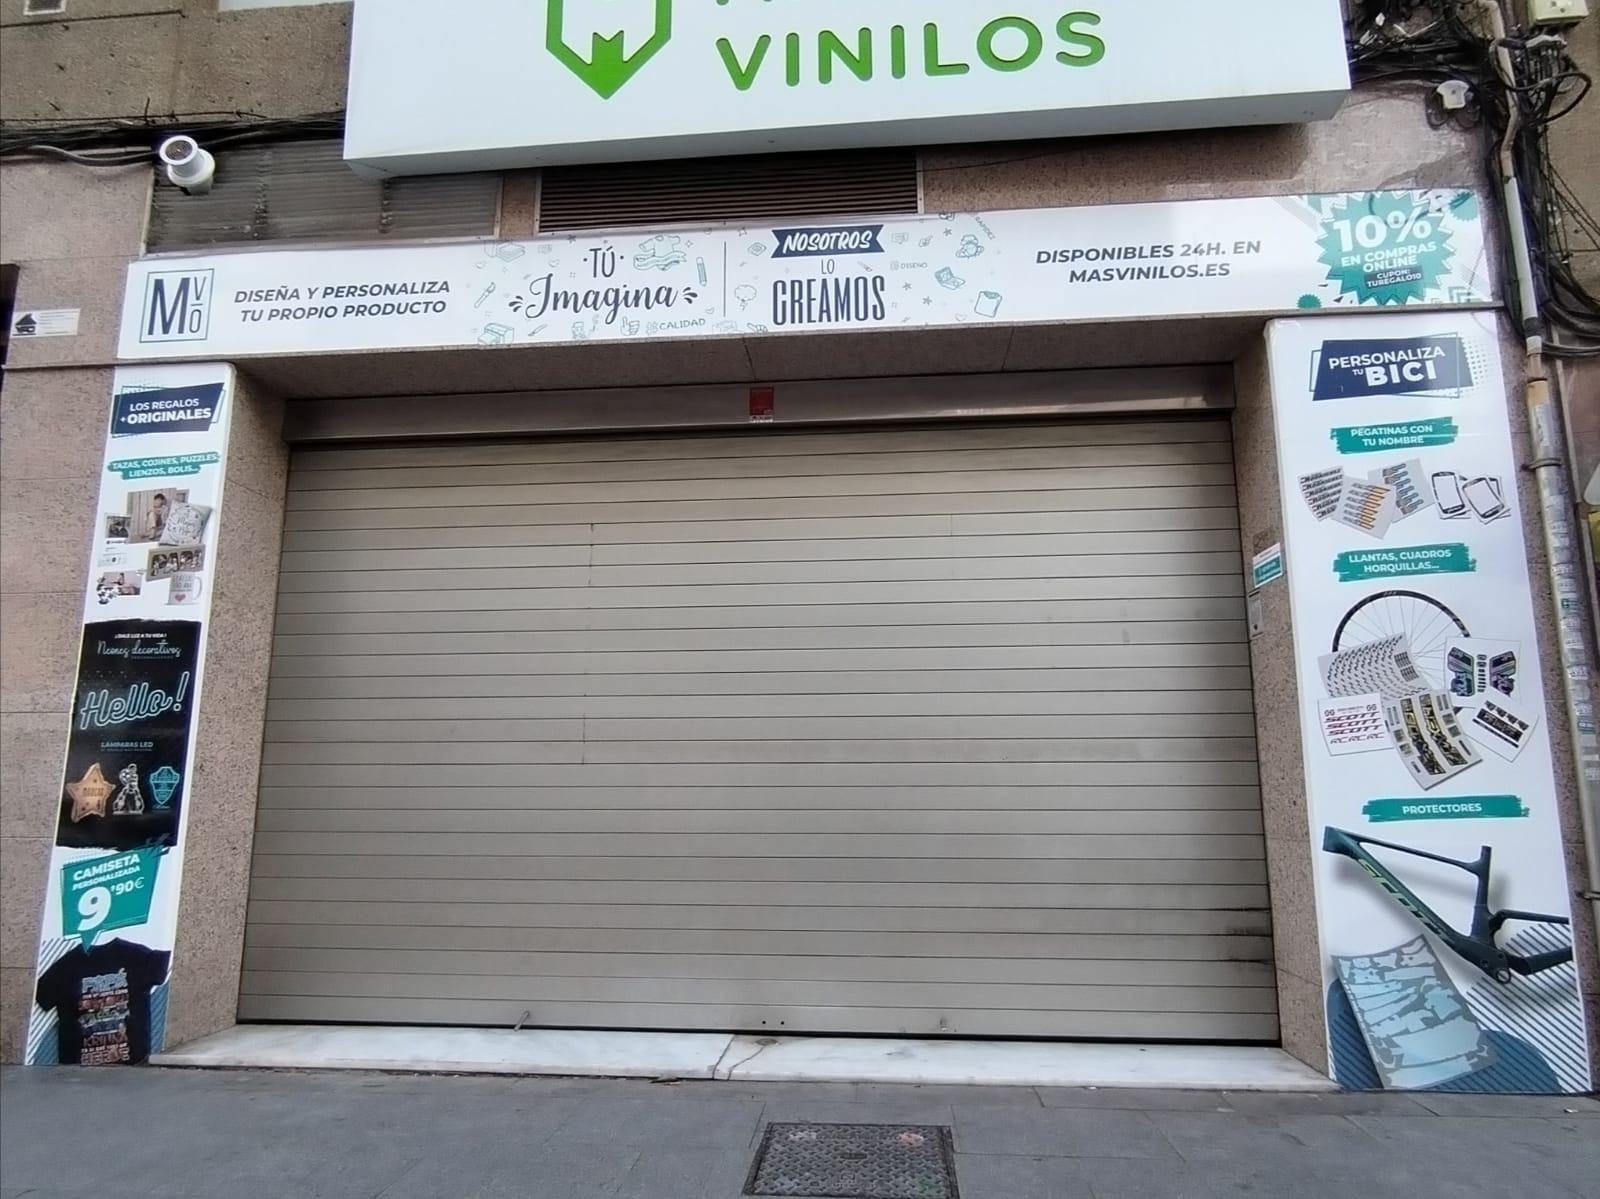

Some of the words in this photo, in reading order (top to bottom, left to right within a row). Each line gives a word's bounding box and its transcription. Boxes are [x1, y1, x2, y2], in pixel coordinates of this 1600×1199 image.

[716, 11, 1105, 91] VINILOS
[1333, 206, 1432, 252] 10%
[782, 231, 873, 254] NOSOTROS
[1036, 244, 1174, 264] DISPONIBLES
[1180, 242, 1226, 257] 24H.
[1232, 240, 1261, 254] EN
[1341, 254, 1361, 267] EN
[1364, 242, 1437, 262] COMPRAS
[1363, 255, 1417, 273] ONLINE
[821, 259, 835, 275] LO
[1069, 263, 1230, 283] MASVINILOS.ES
[234, 285, 301, 303] DISEÑA
[307, 287, 318, 299] Y
[322, 281, 450, 299] PERSONALIZA
[525, 273, 678, 325] Imagina
[772, 275, 885, 326] CREAMOS
[241, 309, 263, 322] TU
[268, 306, 337, 321] PROPIO
[343, 300, 447, 317] PRODUCTO
[1328, 346, 1446, 369] PERSONALIZA
[1352, 368, 1364, 376] TU
[1364, 360, 1437, 387] BICI
[129, 402, 150, 412] LOS
[152, 398, 200, 410] REGALOS
[1351, 425, 1409, 437] PEGATINAS
[1410, 425, 1433, 433] CON
[1362, 438, 1376, 447] TU
[1378, 436, 1424, 446] NOMBRE
[1349, 552, 1396, 563] LLANTAS,
[1400, 549, 1452, 561] CUADROS
[80, 671, 190, 730] Hello!
[1403, 803, 1482, 814] PROTECTORES
[72, 854, 140, 881] CAMISETA
[72, 865, 141, 891] PERSONALIZADA
